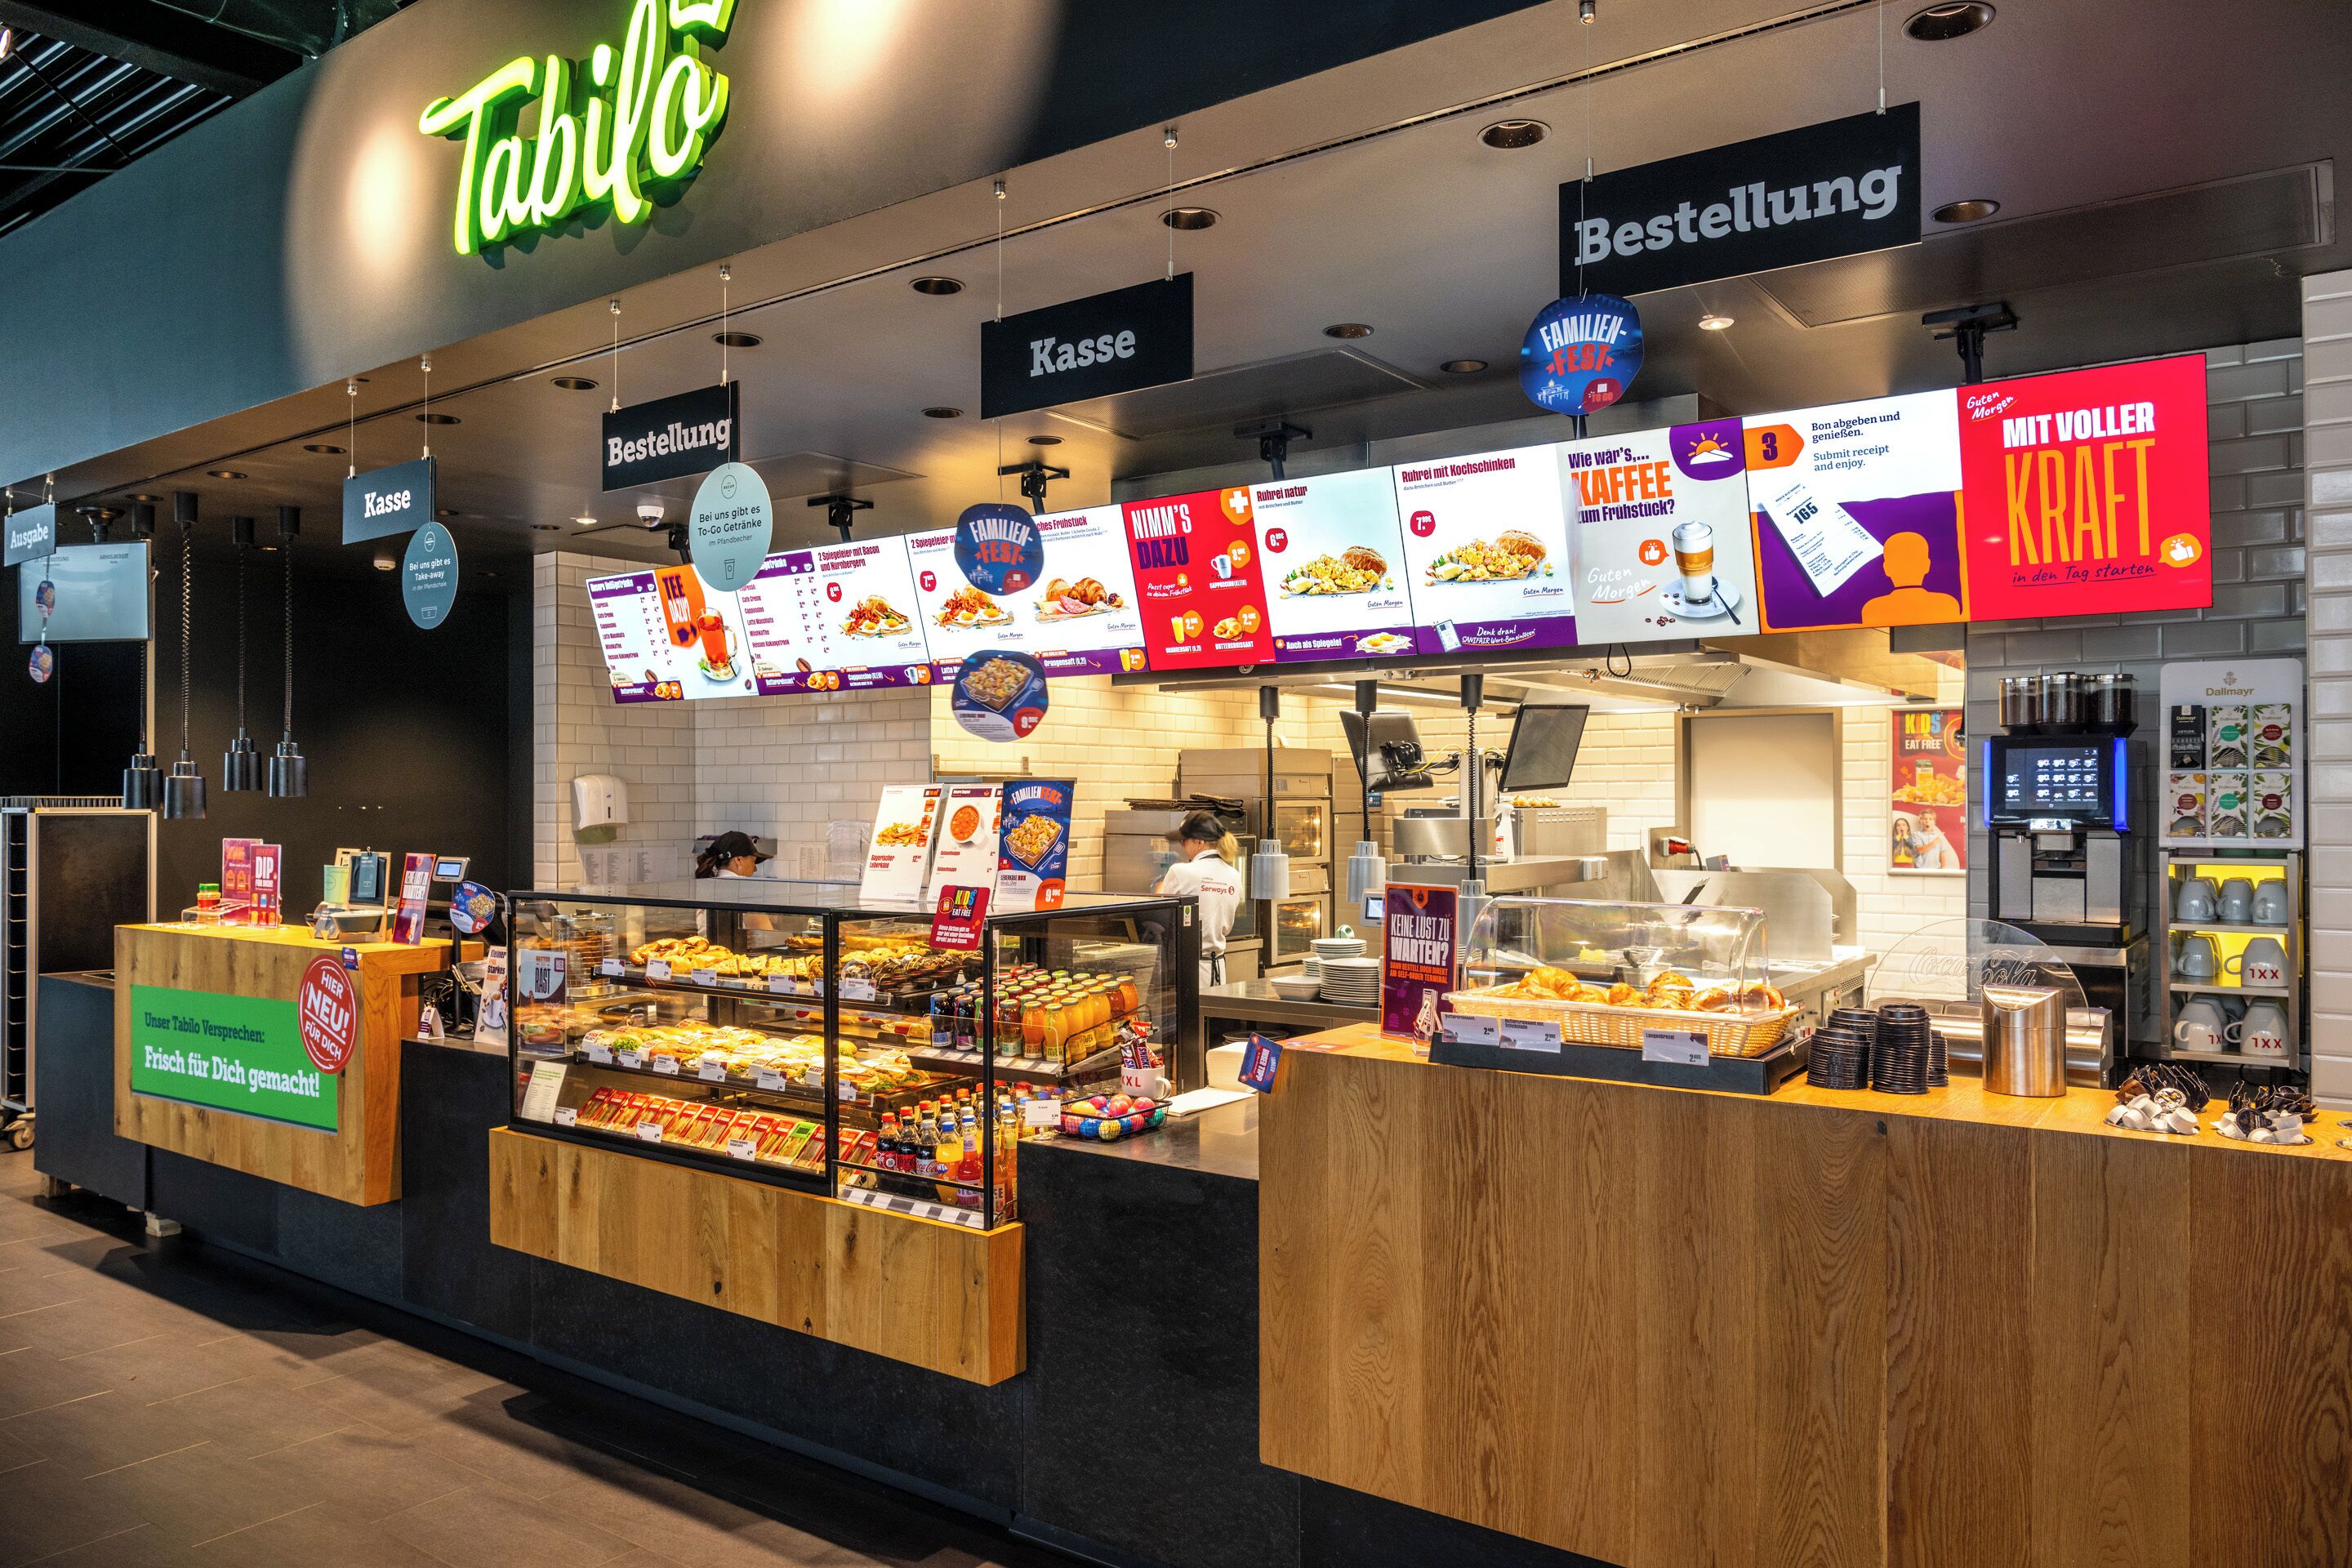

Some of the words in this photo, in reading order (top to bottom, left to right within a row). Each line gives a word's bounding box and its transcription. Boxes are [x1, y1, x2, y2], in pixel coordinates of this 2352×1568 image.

[419, 0, 729, 255] Tabilo
[1574, 165, 1902, 266] Bestellung
[1539, 314, 1627, 352] FAMILIEN-
[1031, 330, 1135, 377] Kasse
[1553, 343, 1610, 376] FEST
[1967, 391, 2000, 409] Guten
[1972, 395, 2014, 419] Morgen
[1811, 422, 1831, 431] Bon
[1833, 416, 1878, 429] abgeben
[1879, 412, 1900, 422] und
[2002, 413, 2051, 448] MIT
[2056, 402, 2155, 442] VOLLER
[608, 418, 732, 467] Bestellung
[1762, 432, 1778, 461] 3
[1812, 428, 1864, 443] genießen.
[1568, 453, 1592, 469] Wie
[1813, 450, 1850, 461] Submit
[1852, 444, 1890, 457] receipt
[1402, 469, 1432, 483] Rührei
[1433, 466, 1449, 479] mit
[1450, 457, 1515, 476] Kochschinken
[1814, 462, 1833, 471] and
[1835, 458, 1866, 470] enjoy.
[1257, 489, 1283, 501] Rührei
[1285, 485, 1307, 498] natur
[1571, 461, 1673, 506] KAFFEE
[364, 490, 411, 518] Kasse
[1578, 508, 1600, 523] zum
[1602, 498, 1675, 521] Frühstück?
[1793, 502, 1818, 524] 165
[2005, 438, 2156, 566] KRAFT
[700, 512, 711, 523] Bei
[715, 511, 729, 521] uns
[732, 507, 749, 519] gibt
[751, 506, 760, 514] es
[1131, 504, 1192, 539] NIMM'S
[11, 523, 48, 549] Ausgabe
[697, 523, 722, 536] To-Go
[724, 519, 762, 533] Getränke
[969, 519, 1034, 547] FAMILIEN-
[717, 534, 752, 546] Pfandbecher
[911, 540, 915, 549] 2
[916, 536, 948, 549] Spiegeleier
[818, 553, 822, 561] 2
[822, 549, 852, 560] Spiegeleier
[853, 547, 862, 555] mit
[863, 545, 880, 554] Bacon
[980, 540, 1021, 566] FEST
[1137, 537, 1189, 569] DAZU
[409, 563, 418, 571] Bei
[420, 562, 430, 570] uns
[431, 559, 443, 568] gibt
[416, 571, 444, 581] Take-away
[821, 562, 830, 571] und
[1588, 568, 1632, 583] Guten
[2012, 572, 2025, 583] in
[2032, 569, 2057, 581] den
[2065, 566, 2088, 581] Tag
[2095, 563, 2154, 577] starten
[424, 581, 447, 590] Pfandschale
[662, 574, 686, 600] TEE
[1523, 587, 1539, 595] Guten
[1542, 586, 1563, 595] Morgen
[1592, 579, 1650, 601] Morgen
[668, 598, 692, 624] DAZU?
[1462, 635, 1490, 644] SANIFAIR
[1477, 626, 1495, 636] Denk
[1497, 625, 1517, 635] dran!
[1286, 640, 1302, 649] Auch
[1303, 639, 1312, 648] als
[1312, 638, 1342, 648] Spiegelei
[2206, 688, 2254, 697] Dallmayr
[1905, 713, 1941, 734] KIDS
[1905, 739, 1921, 750] EAT
[1922, 738, 1941, 750] FREE
[256, 857, 274, 879] DIP
[955, 890, 976, 906] KIDS
[1201, 884, 1227, 894] Serways
[952, 908, 960, 916] EAT
[1391, 914, 1414, 938] KEINE
[1415, 916, 1437, 939] LUST
[1439, 918, 1450, 941] ZU
[1391, 937, 1449, 966] WARTEN?
[488, 965, 505, 973] Starkes
[1398, 970, 1423, 980] SELF-ORDER
[1424, 974, 1448, 983] TERMINAL
[1402, 963, 1419, 973] BESTELL
[1432, 966, 1448, 975] DIREKT
[322, 970, 343, 999] HIER
[535, 969, 550, 994] RAST
[307, 982, 350, 1038] NEU!
[145, 1012, 171, 1030] Unser
[172, 1017, 200, 1034] Tabilo
[202, 1020, 265, 1043] Versprechen:
[305, 1021, 321, 1041] FÜR
[322, 1035, 342, 1060] DICH
[145, 1045, 185, 1073] Frisch
[187, 1053, 210, 1078] für
[212, 1056, 246, 1085] Dich
[248, 1068, 319, 1098] gemacht!
